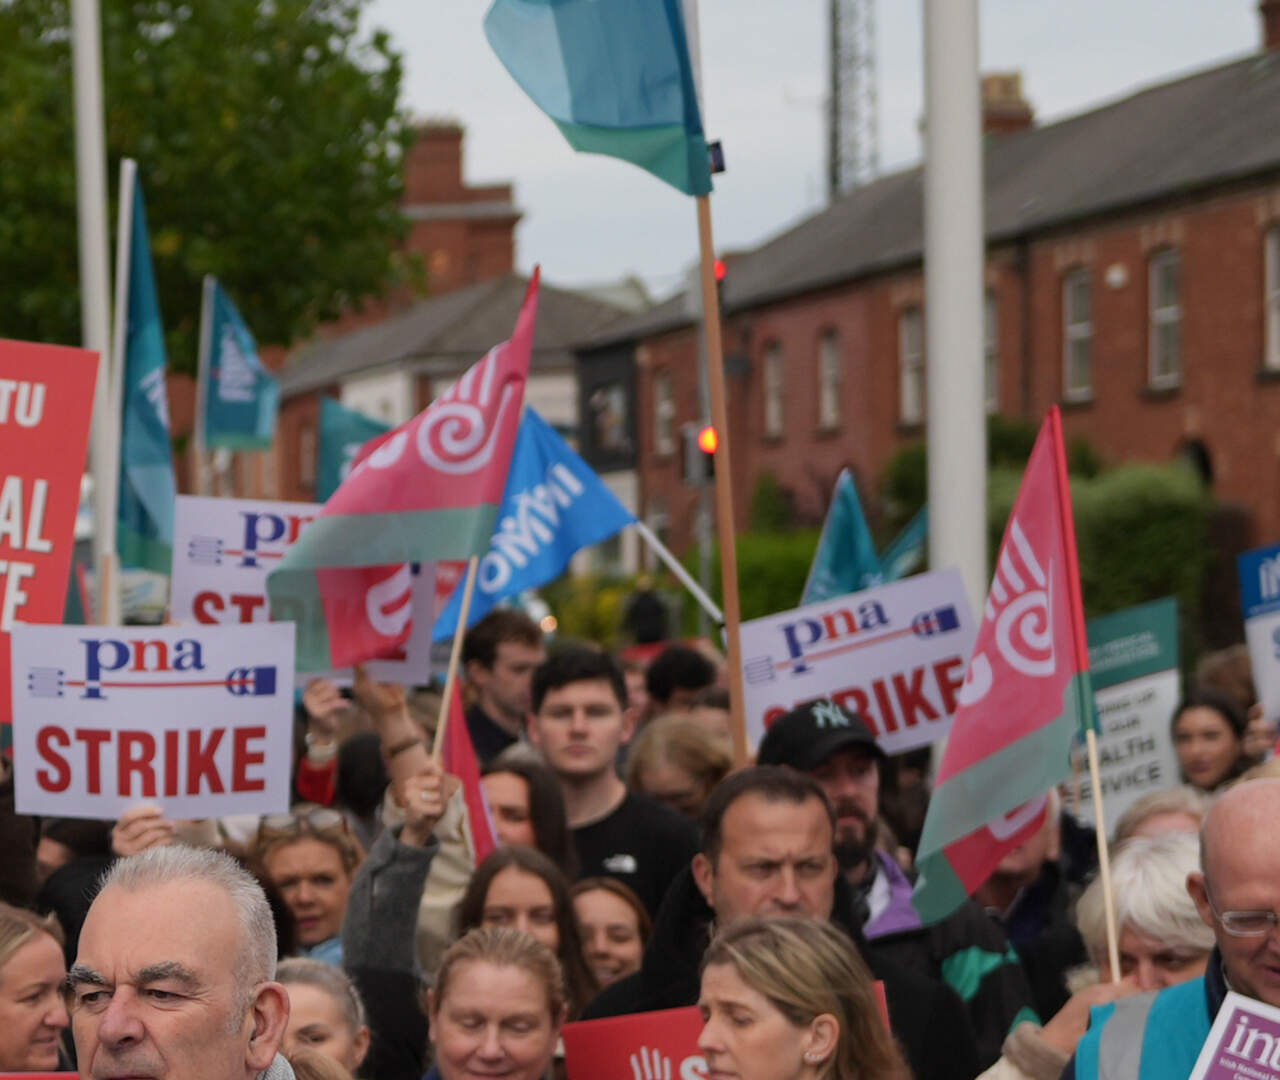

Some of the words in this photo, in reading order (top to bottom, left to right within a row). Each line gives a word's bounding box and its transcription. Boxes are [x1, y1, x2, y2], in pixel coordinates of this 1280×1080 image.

[79, 639, 206, 700] pna
[780, 597, 888, 676] pna
[763, 657, 964, 739] RIKE
[35, 725, 267, 798] STRIKE
